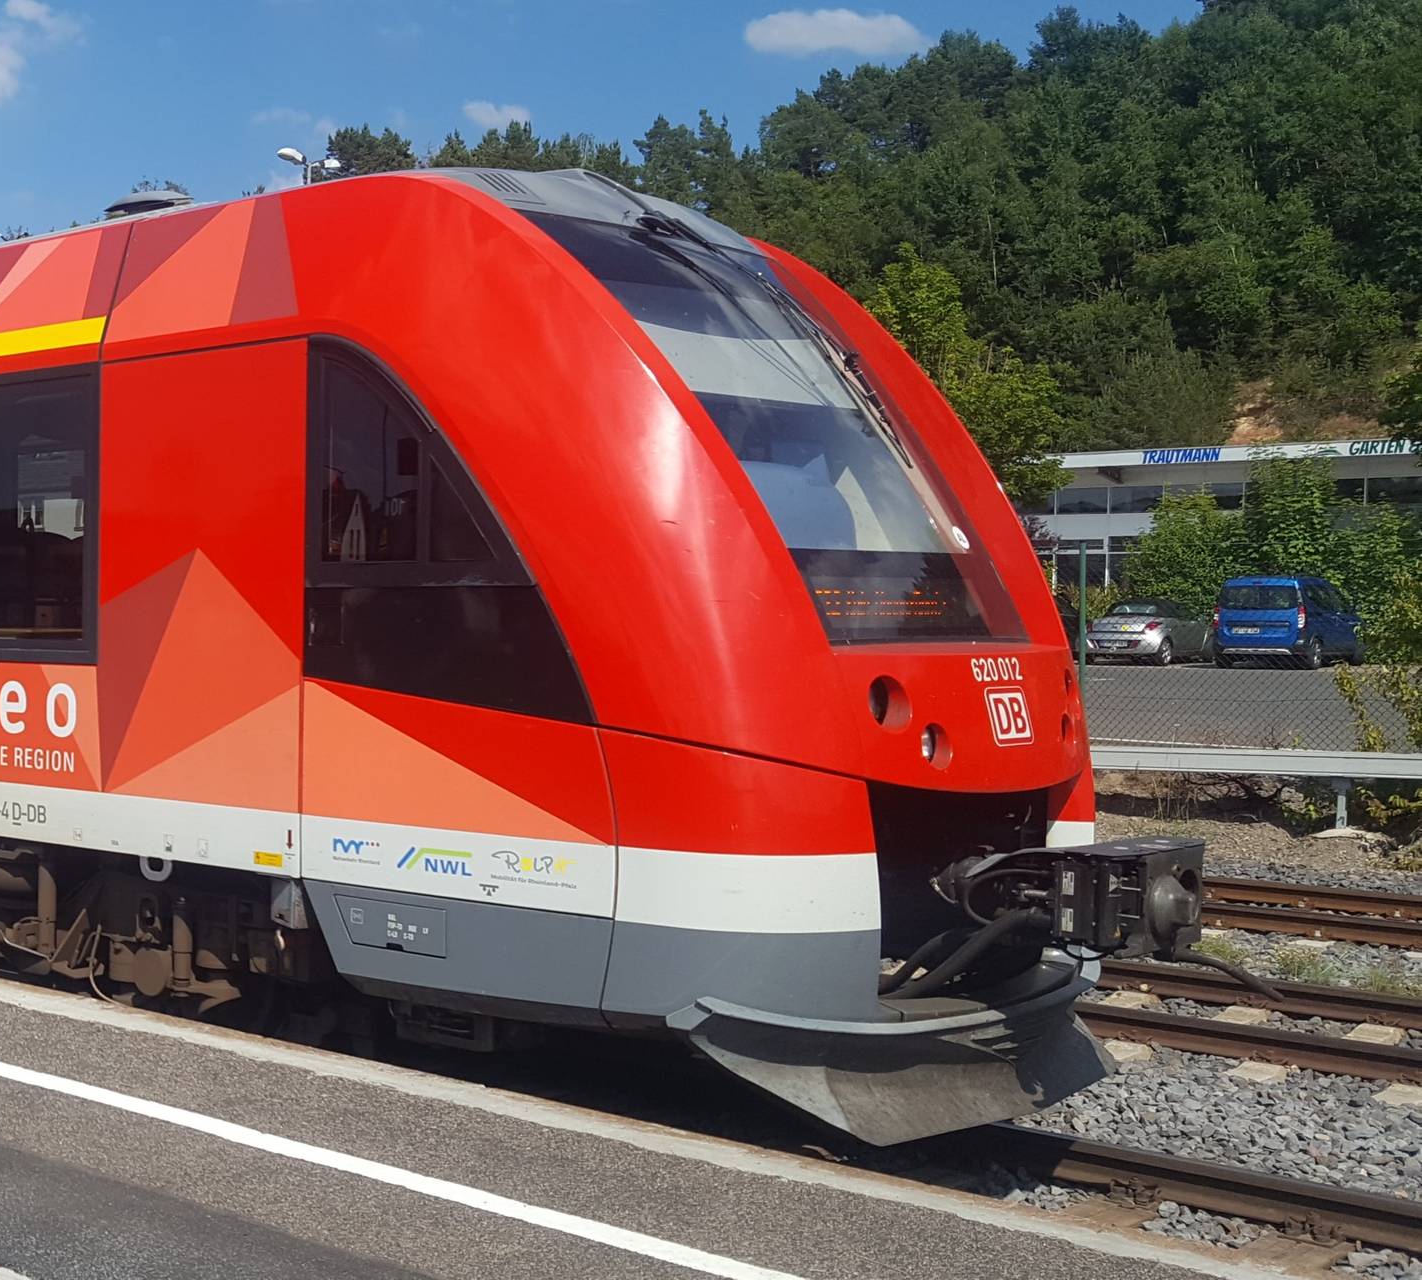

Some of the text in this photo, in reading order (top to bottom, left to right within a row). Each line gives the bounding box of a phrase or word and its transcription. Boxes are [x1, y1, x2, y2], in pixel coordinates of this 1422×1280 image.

[1143, 448, 1221, 464] TRAUTMANN
[1349, 439, 1406, 455] GARTEN
[971, 657, 1023, 682] 620 012
[990, 693, 1029, 738] DB
[14, 748, 75, 772] REGION
[424, 858, 472, 876] NWL
